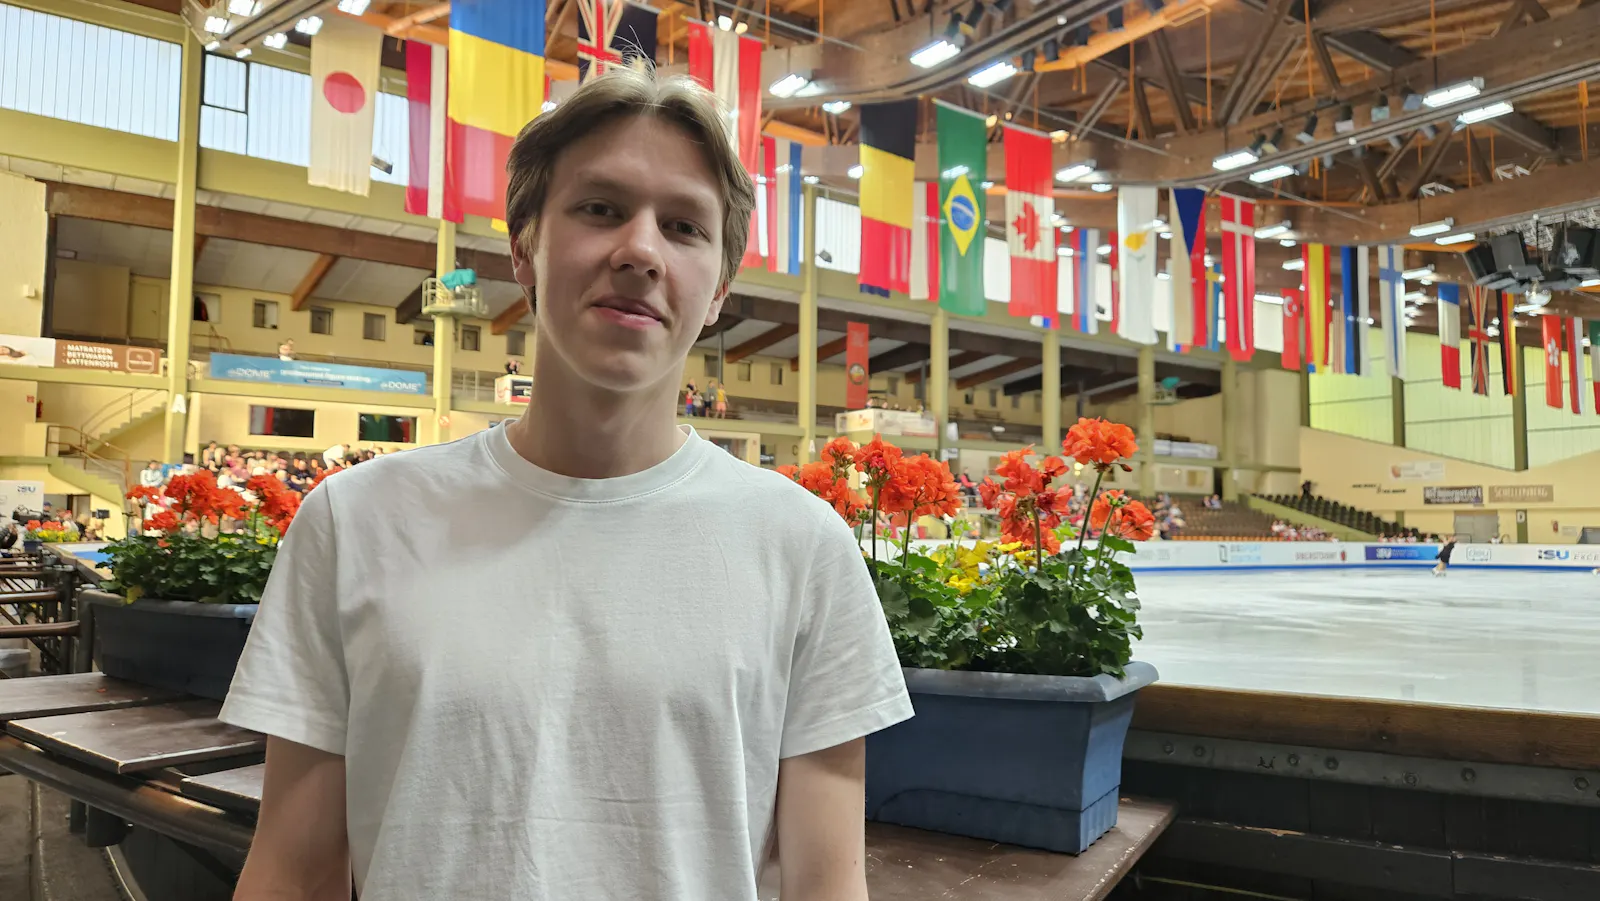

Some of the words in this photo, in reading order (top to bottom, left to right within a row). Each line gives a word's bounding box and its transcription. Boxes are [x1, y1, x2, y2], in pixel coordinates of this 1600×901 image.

[66, 344, 113, 355] MATRATZEN
[66, 351, 114, 361] BETTWAREN
[66, 358, 119, 368] LATTENROSTE
[172, 393, 187, 414] A
[1516, 510, 1526, 523] D
